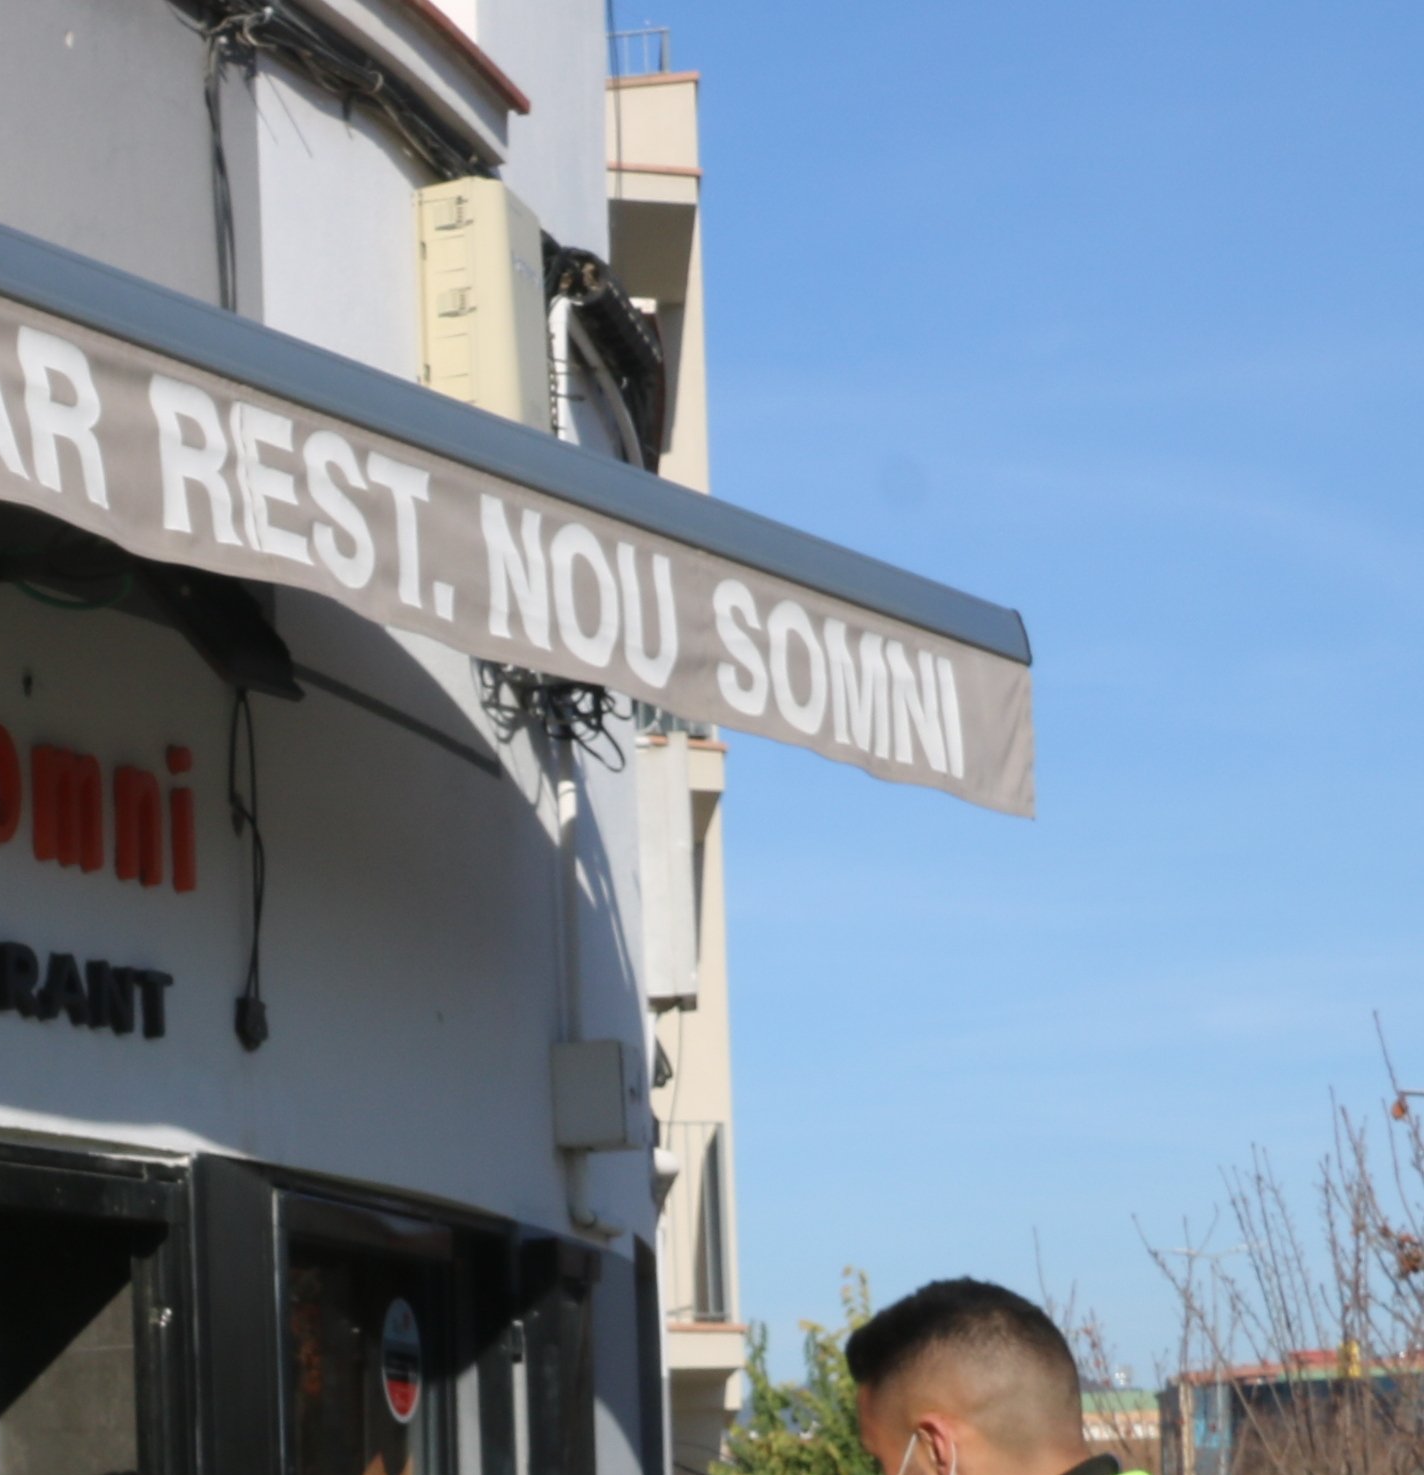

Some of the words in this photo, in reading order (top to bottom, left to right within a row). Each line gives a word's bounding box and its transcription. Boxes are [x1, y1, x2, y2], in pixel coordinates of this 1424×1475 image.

[150, 374, 456, 618] REST.
[478, 492, 680, 689] NOU
[712, 579, 964, 781] SOMNI
